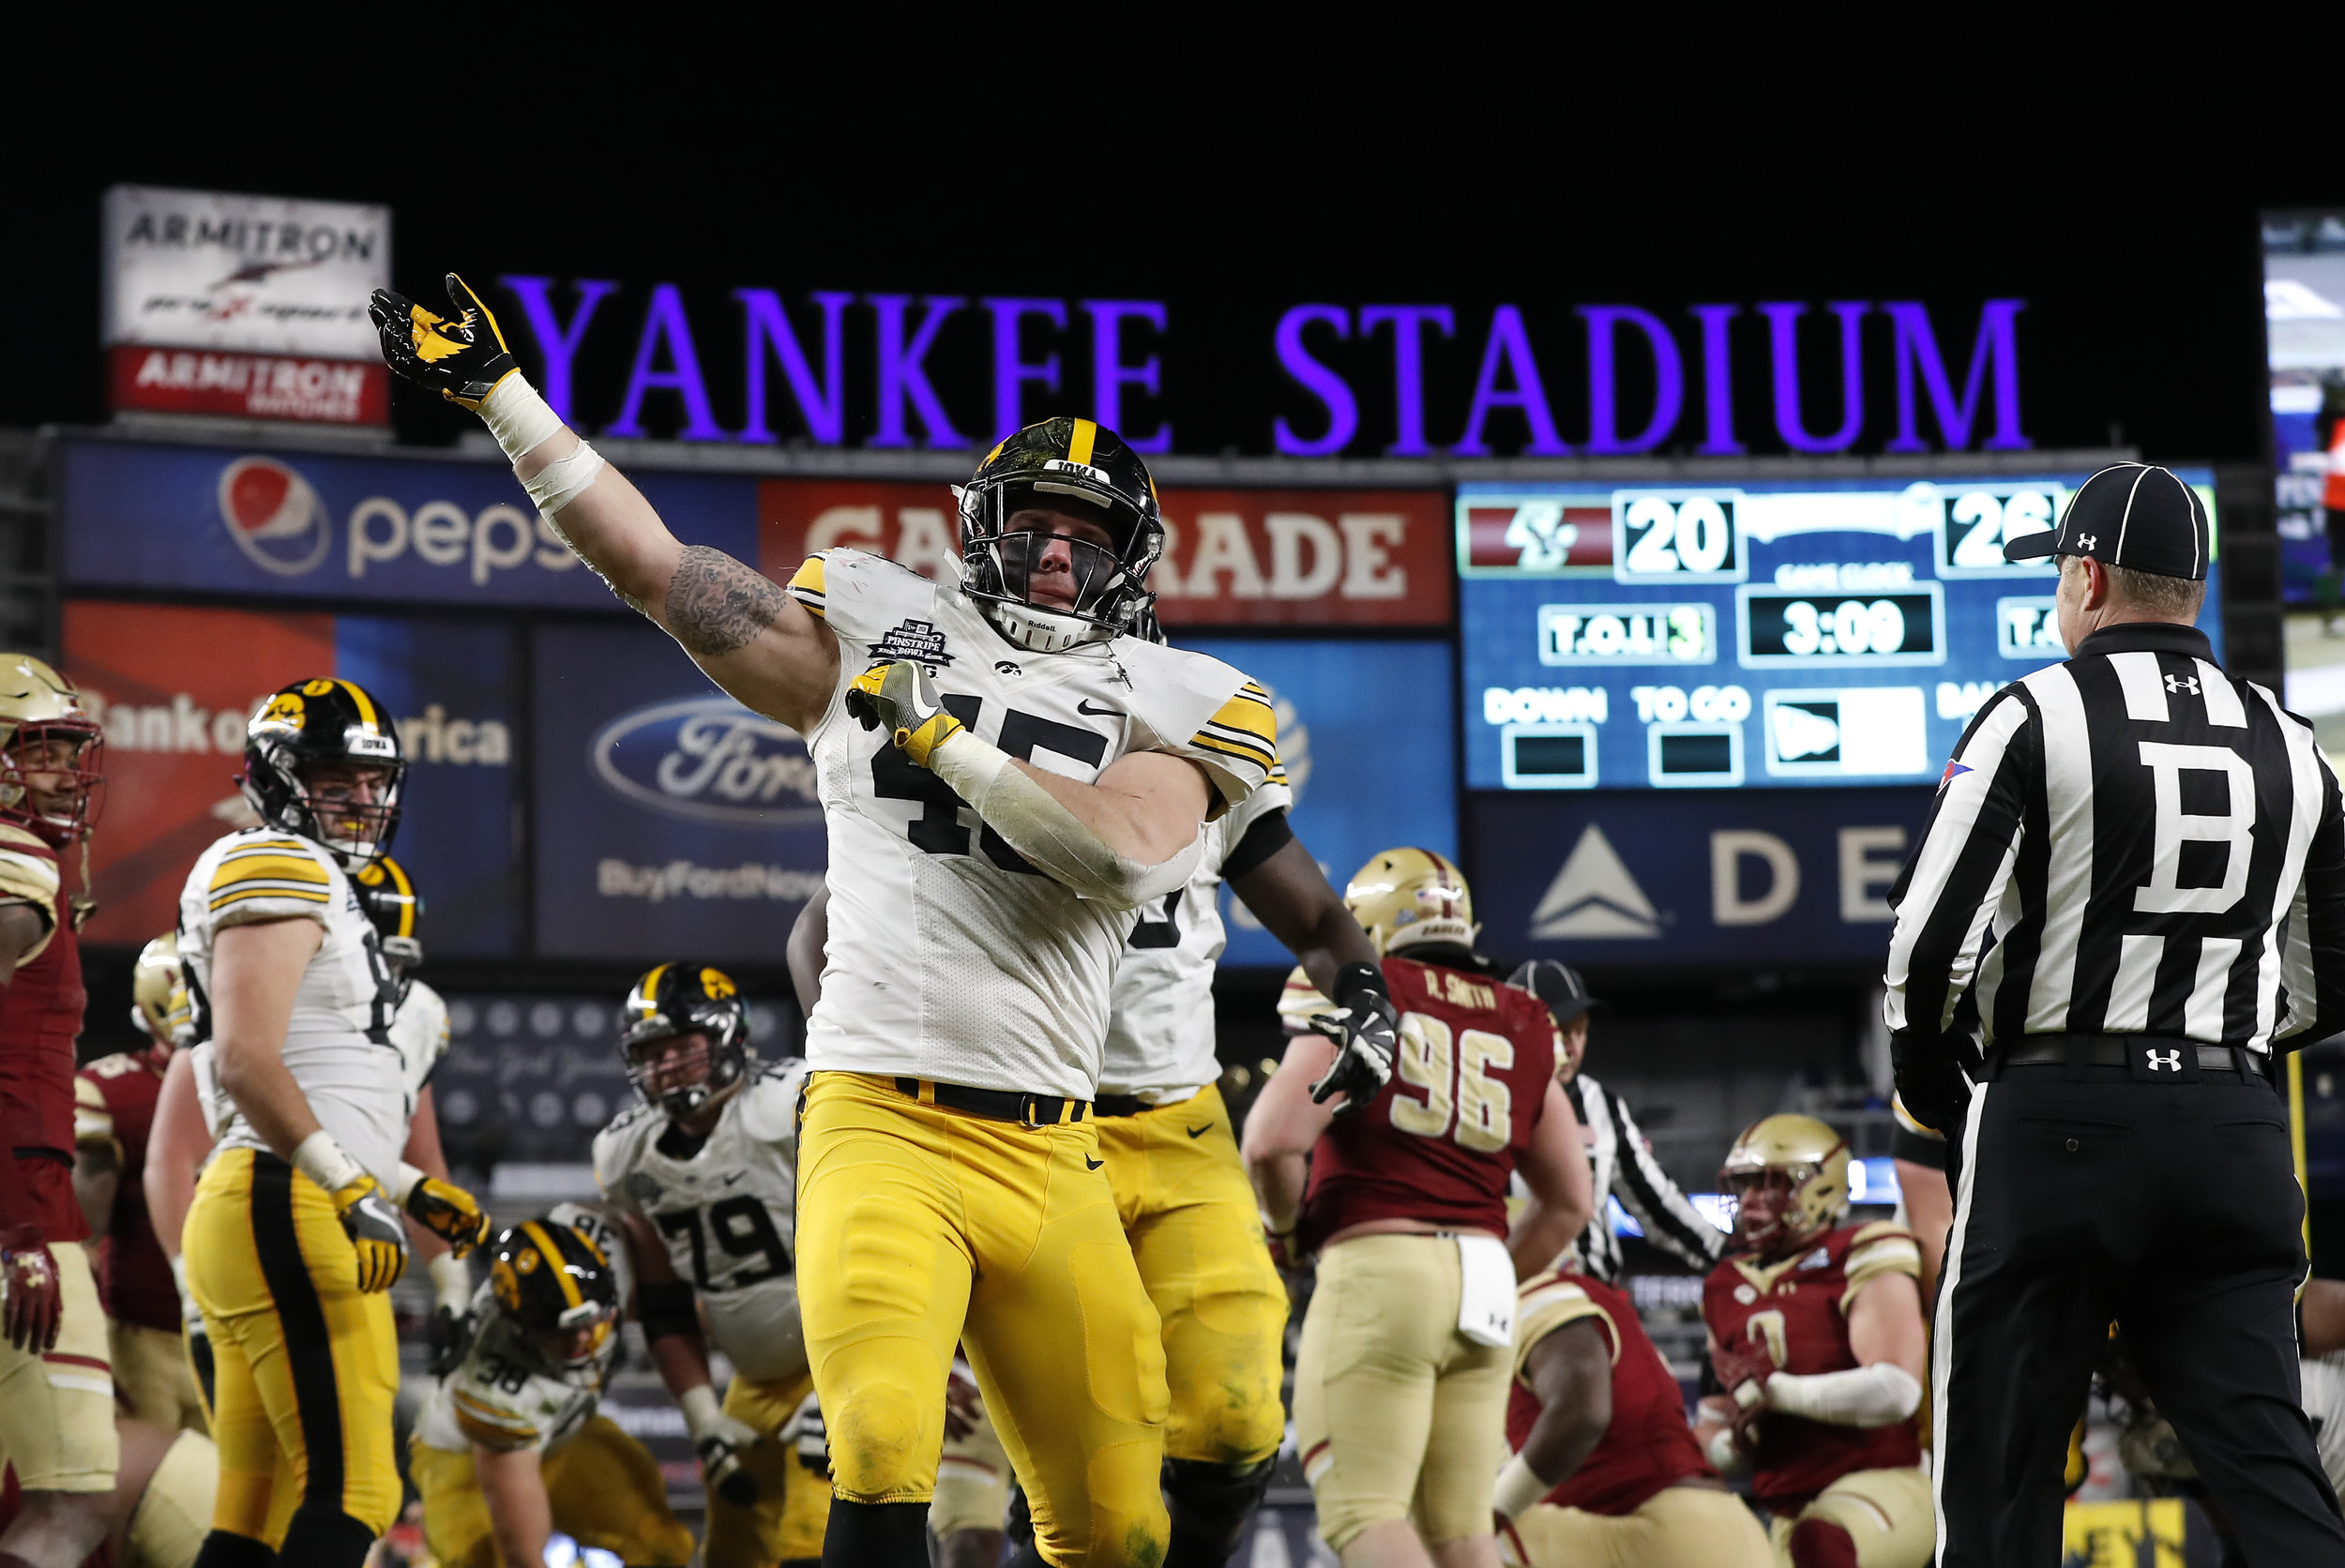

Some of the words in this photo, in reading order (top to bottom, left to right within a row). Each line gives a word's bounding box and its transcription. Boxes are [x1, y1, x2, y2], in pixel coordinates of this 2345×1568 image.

[126, 212, 373, 263] ARMITRON
[137, 351, 366, 401] ARMITRON
[499, 274, 1172, 454] YANKEE
[1272, 298, 2034, 458] STADIUM
[346, 495, 579, 586] peps
[805, 504, 1406, 600] GAADE
[1626, 495, 1730, 573] 20
[1951, 490, 2055, 567] 26
[886, 635, 941, 652] PINSTRIPE
[896, 646, 925, 657] BOWL
[1782, 599, 1905, 655] 3:09
[1484, 686, 1609, 725] DOWN
[1630, 686, 1688, 723] TO
[1689, 685, 1752, 723] GO
[2133, 741, 2255, 914] B
[1388, 1011, 1514, 1153] 96
[654, 1194, 794, 1293] 79
